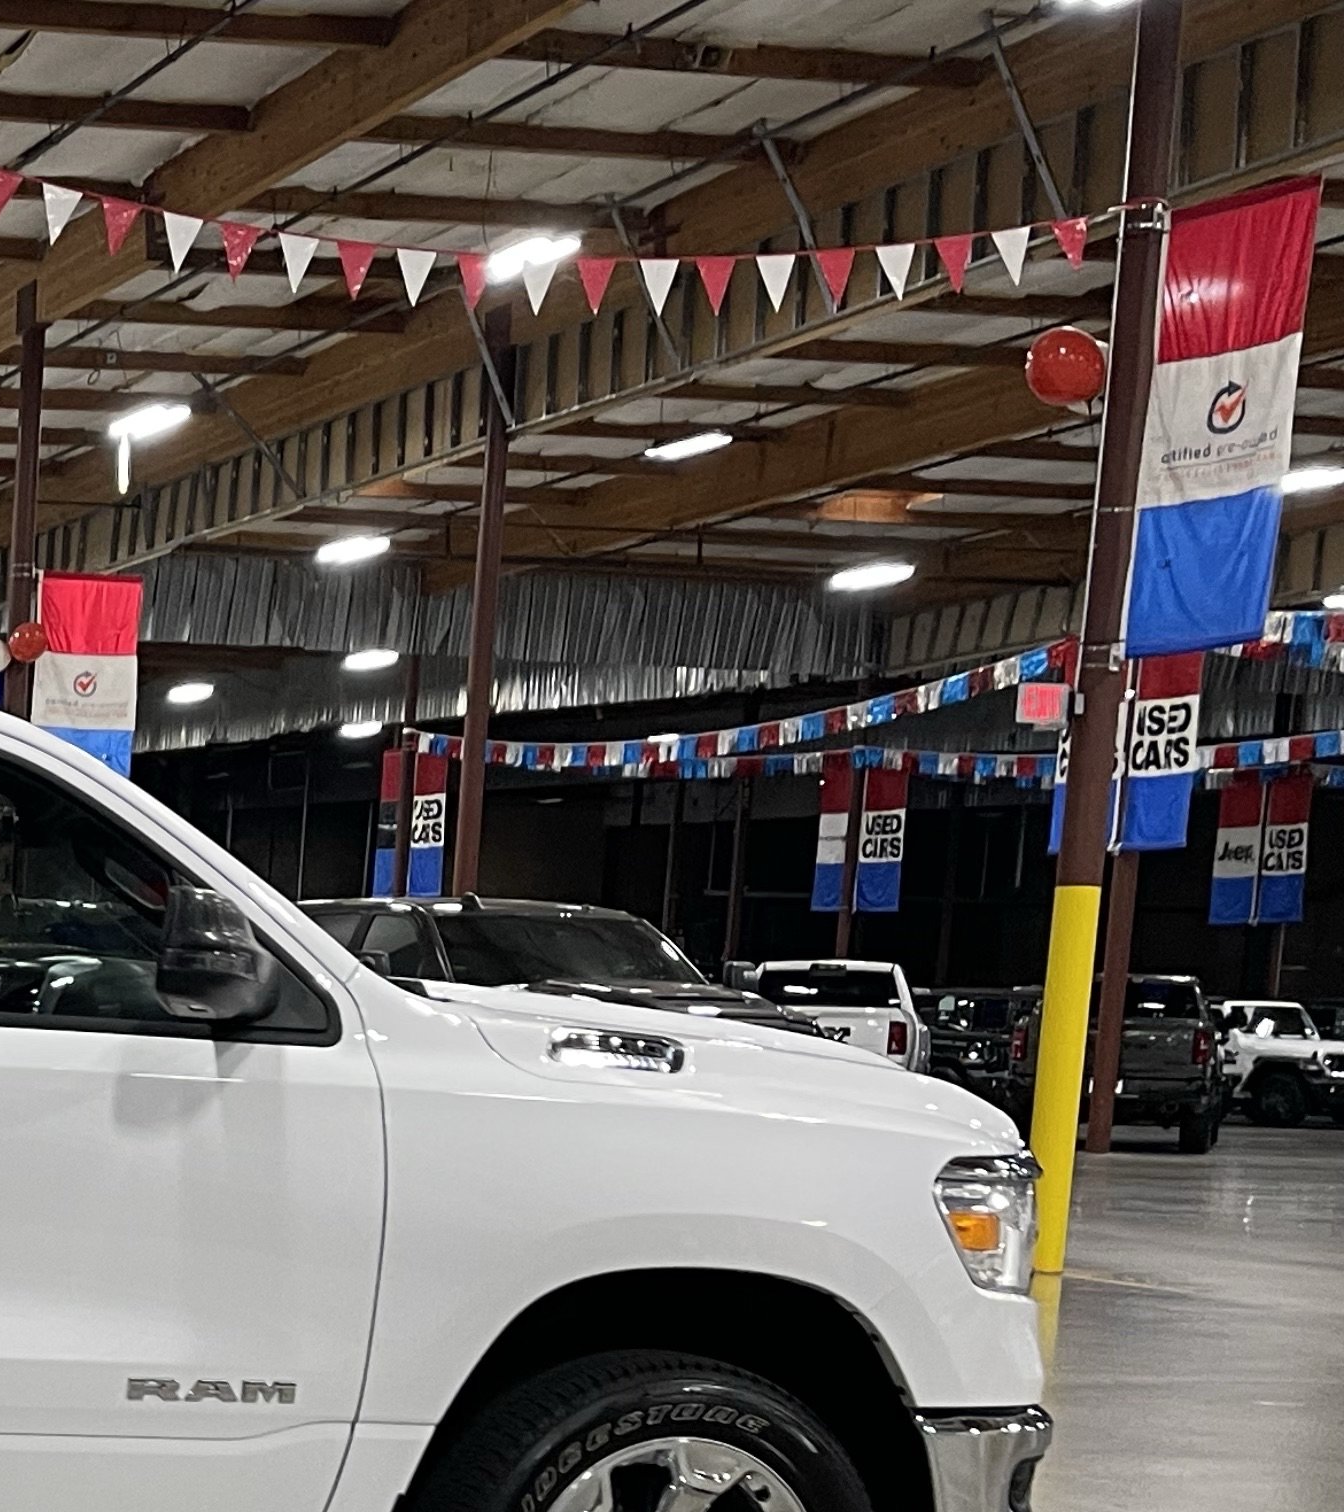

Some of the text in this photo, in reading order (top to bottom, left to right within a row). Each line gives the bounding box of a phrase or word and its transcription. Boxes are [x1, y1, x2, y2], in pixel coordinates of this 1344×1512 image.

[1136, 702, 1192, 737] USED
[1131, 736, 1190, 771] CARS
[865, 813, 903, 836] USED
[126, 1377, 297, 1404] RAM
